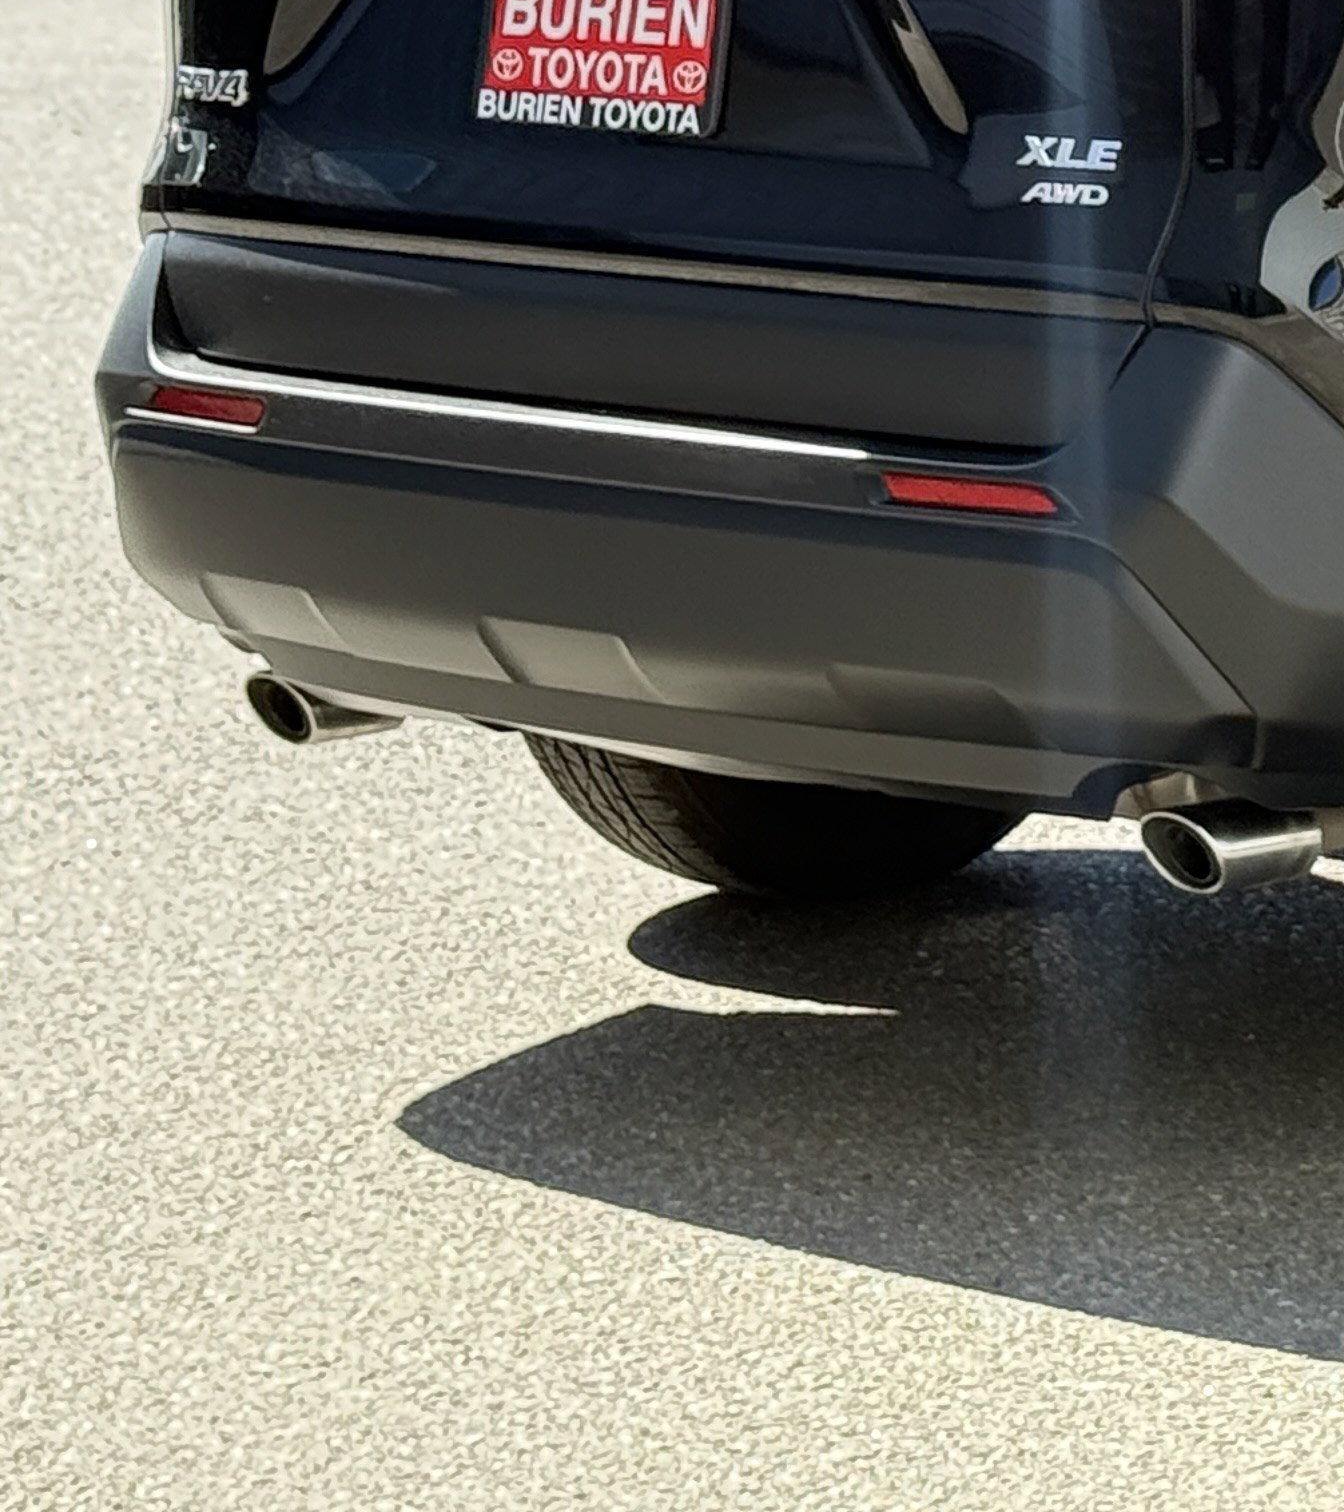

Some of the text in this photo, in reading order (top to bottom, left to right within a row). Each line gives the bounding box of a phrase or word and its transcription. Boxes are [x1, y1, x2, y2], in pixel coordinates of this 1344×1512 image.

[527, 46, 668, 97] TOYOTA
[476, 88, 701, 135] BURIEN TOYOTA
[1015, 134, 1123, 172] XLE
[1020, 181, 1110, 207] AWD
